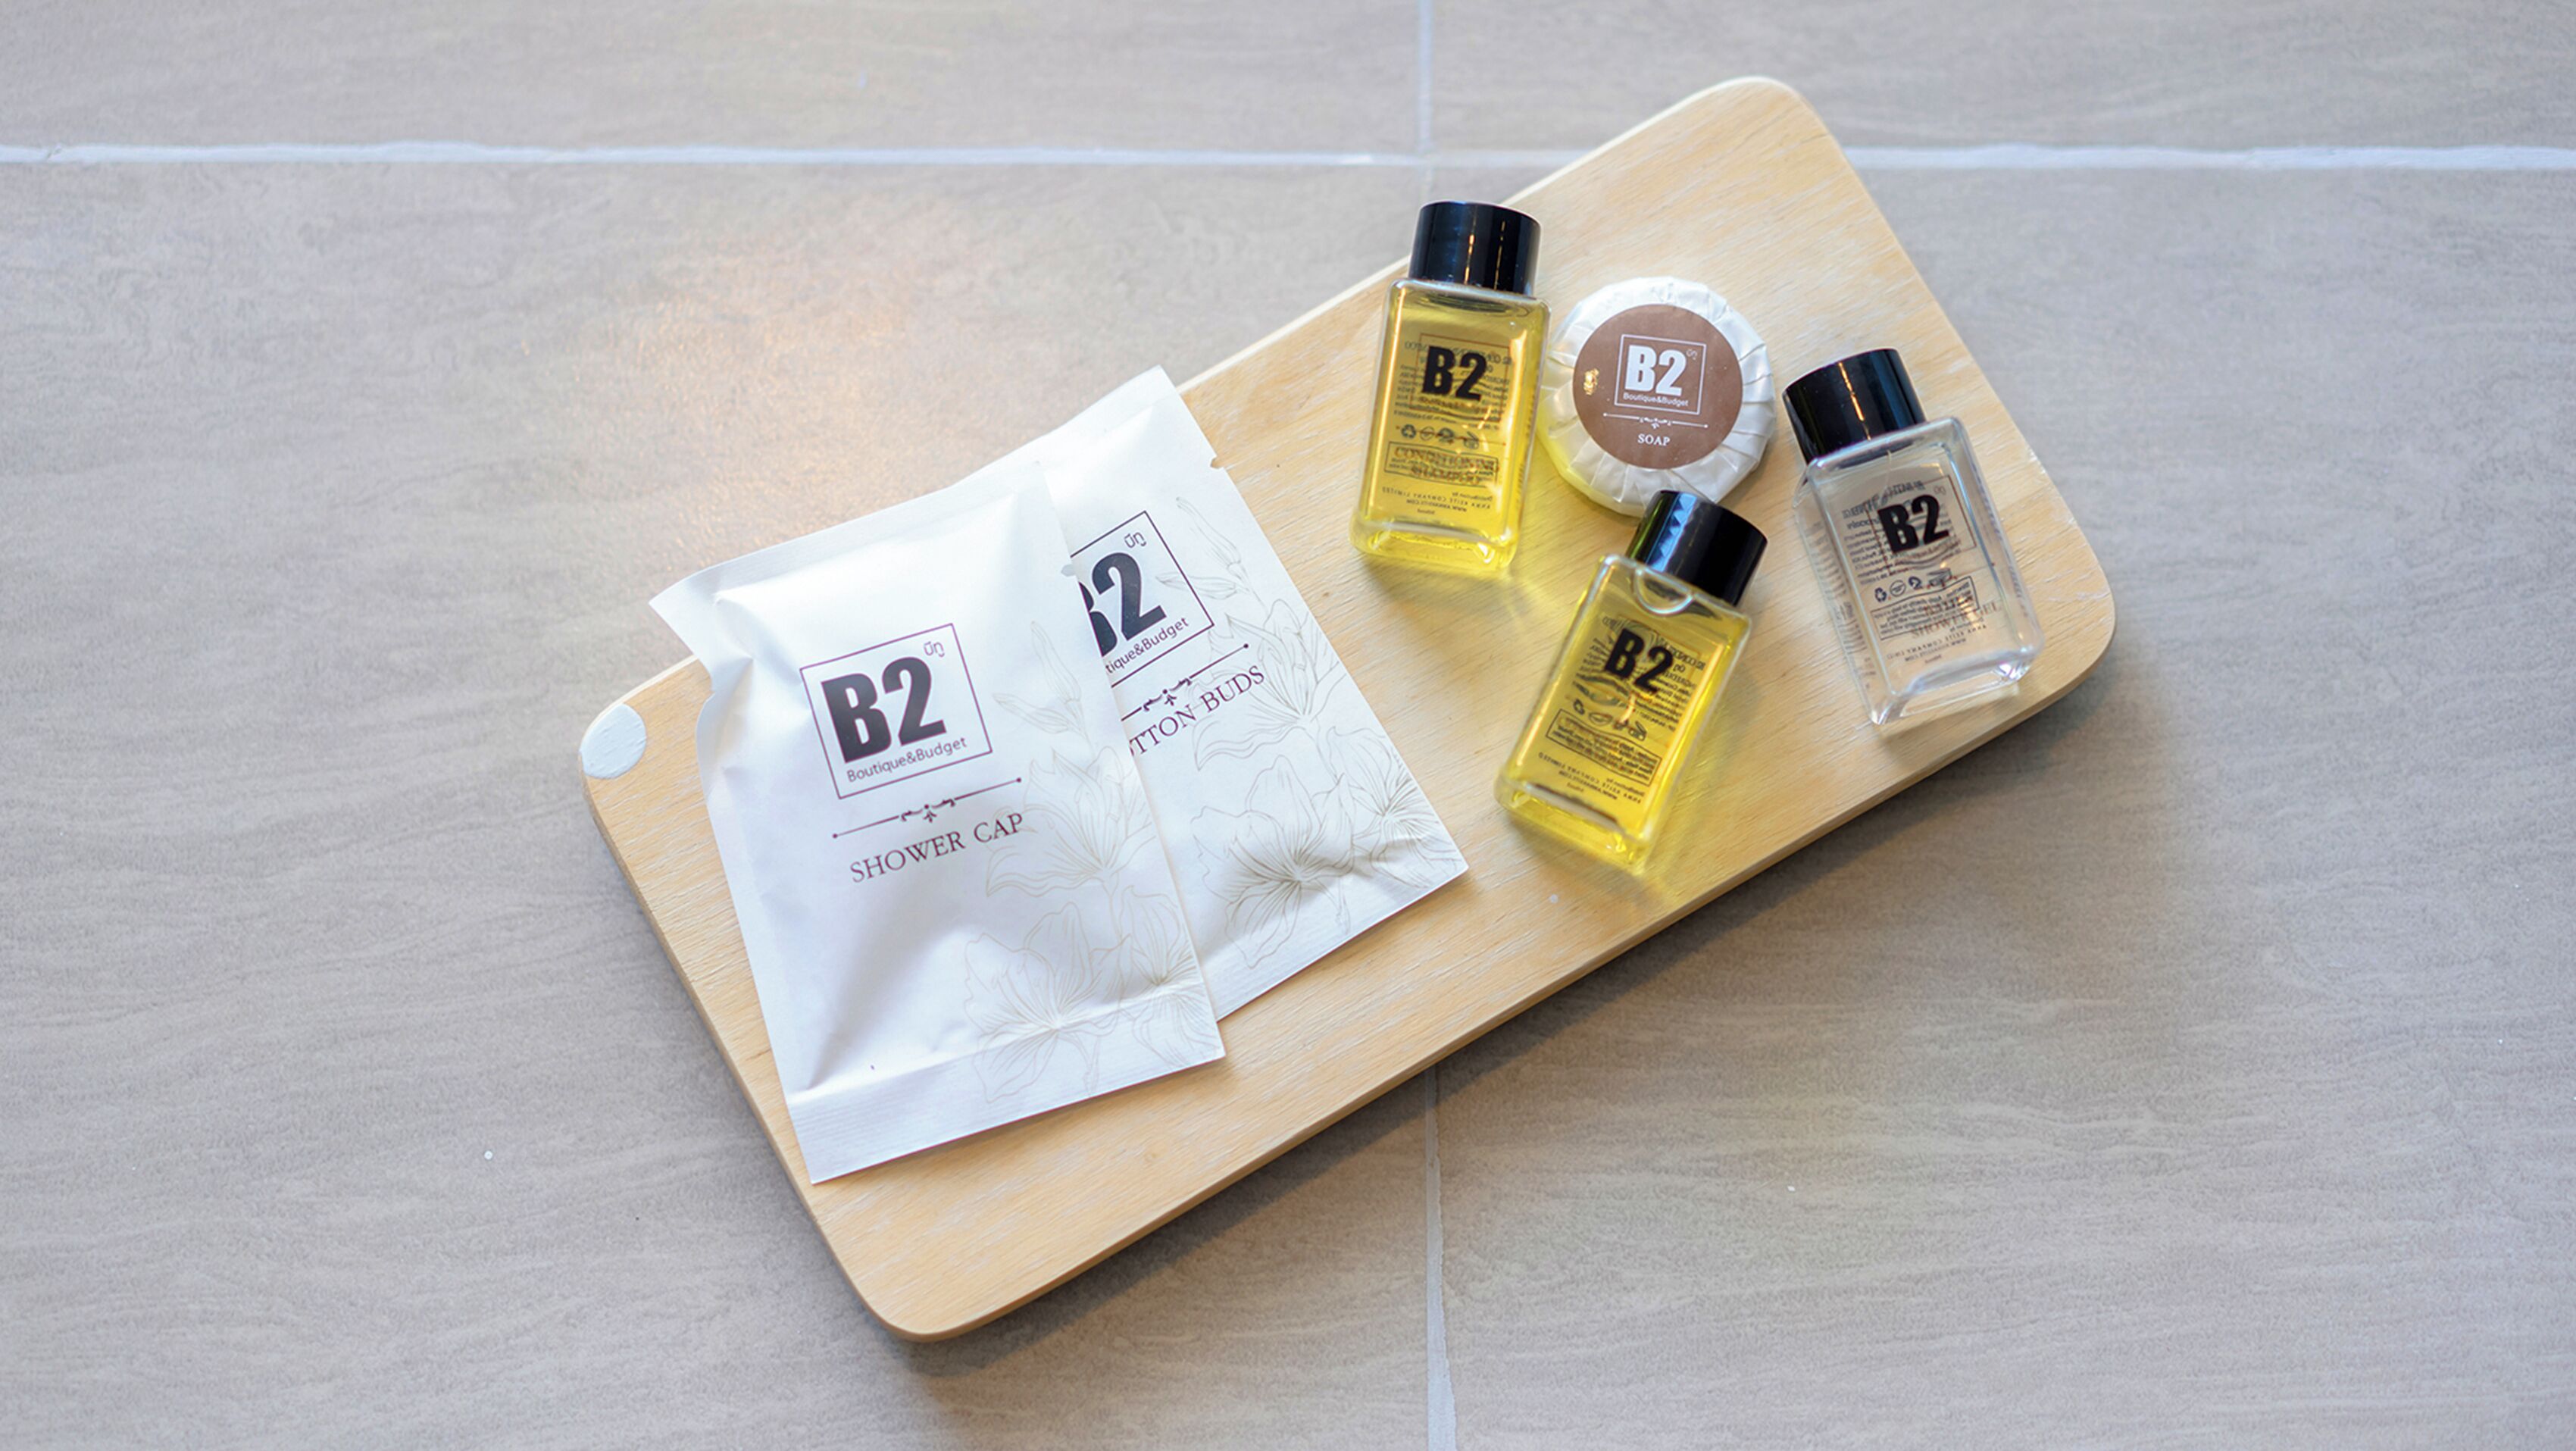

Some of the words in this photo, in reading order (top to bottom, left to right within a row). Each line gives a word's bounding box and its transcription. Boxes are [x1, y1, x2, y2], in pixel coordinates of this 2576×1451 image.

[1421, 346, 1487, 402] B2
[1625, 345, 1687, 396] B2
[1623, 392, 1690, 408] Boutique&Budget
[1637, 433, 1671, 446] SOAP
[1877, 494, 1949, 554] B2
[1605, 628, 1673, 695] B2
[821, 656, 947, 764] B2
[1130, 704, 1197, 756] TTON
[1200, 665, 1265, 712] BUDS
[846, 736, 968, 783] Boutique&Budget
[849, 830, 966, 883] SHOWER
[973, 812, 1024, 844] CAP
